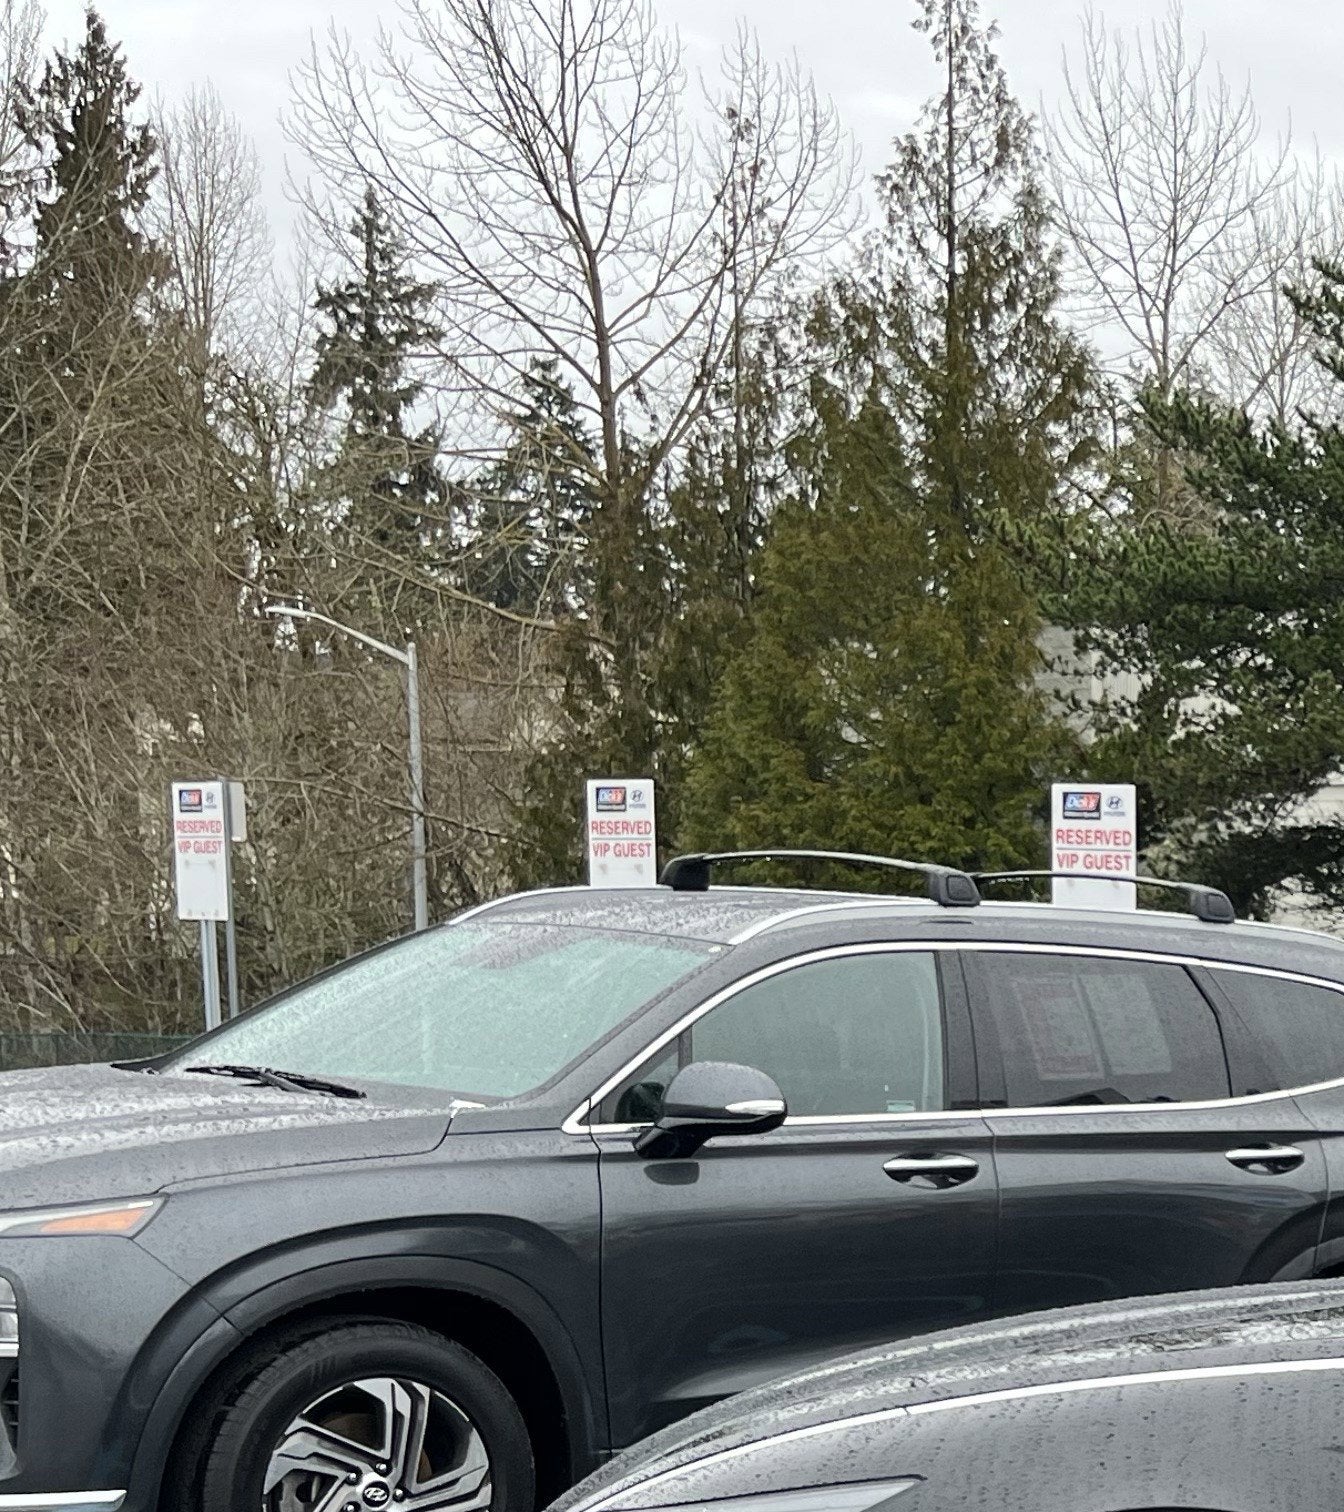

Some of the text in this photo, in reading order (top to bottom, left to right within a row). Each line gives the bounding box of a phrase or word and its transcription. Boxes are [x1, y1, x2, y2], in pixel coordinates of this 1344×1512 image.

[176, 820, 222, 834] RESERVED
[591, 821, 652, 835] RESERVED
[1056, 829, 1132, 846] RESERVED
[193, 840, 223, 854] GUEST
[592, 843, 652, 857] VIP GUEST
[1056, 853, 1132, 871] VIP GUEST
